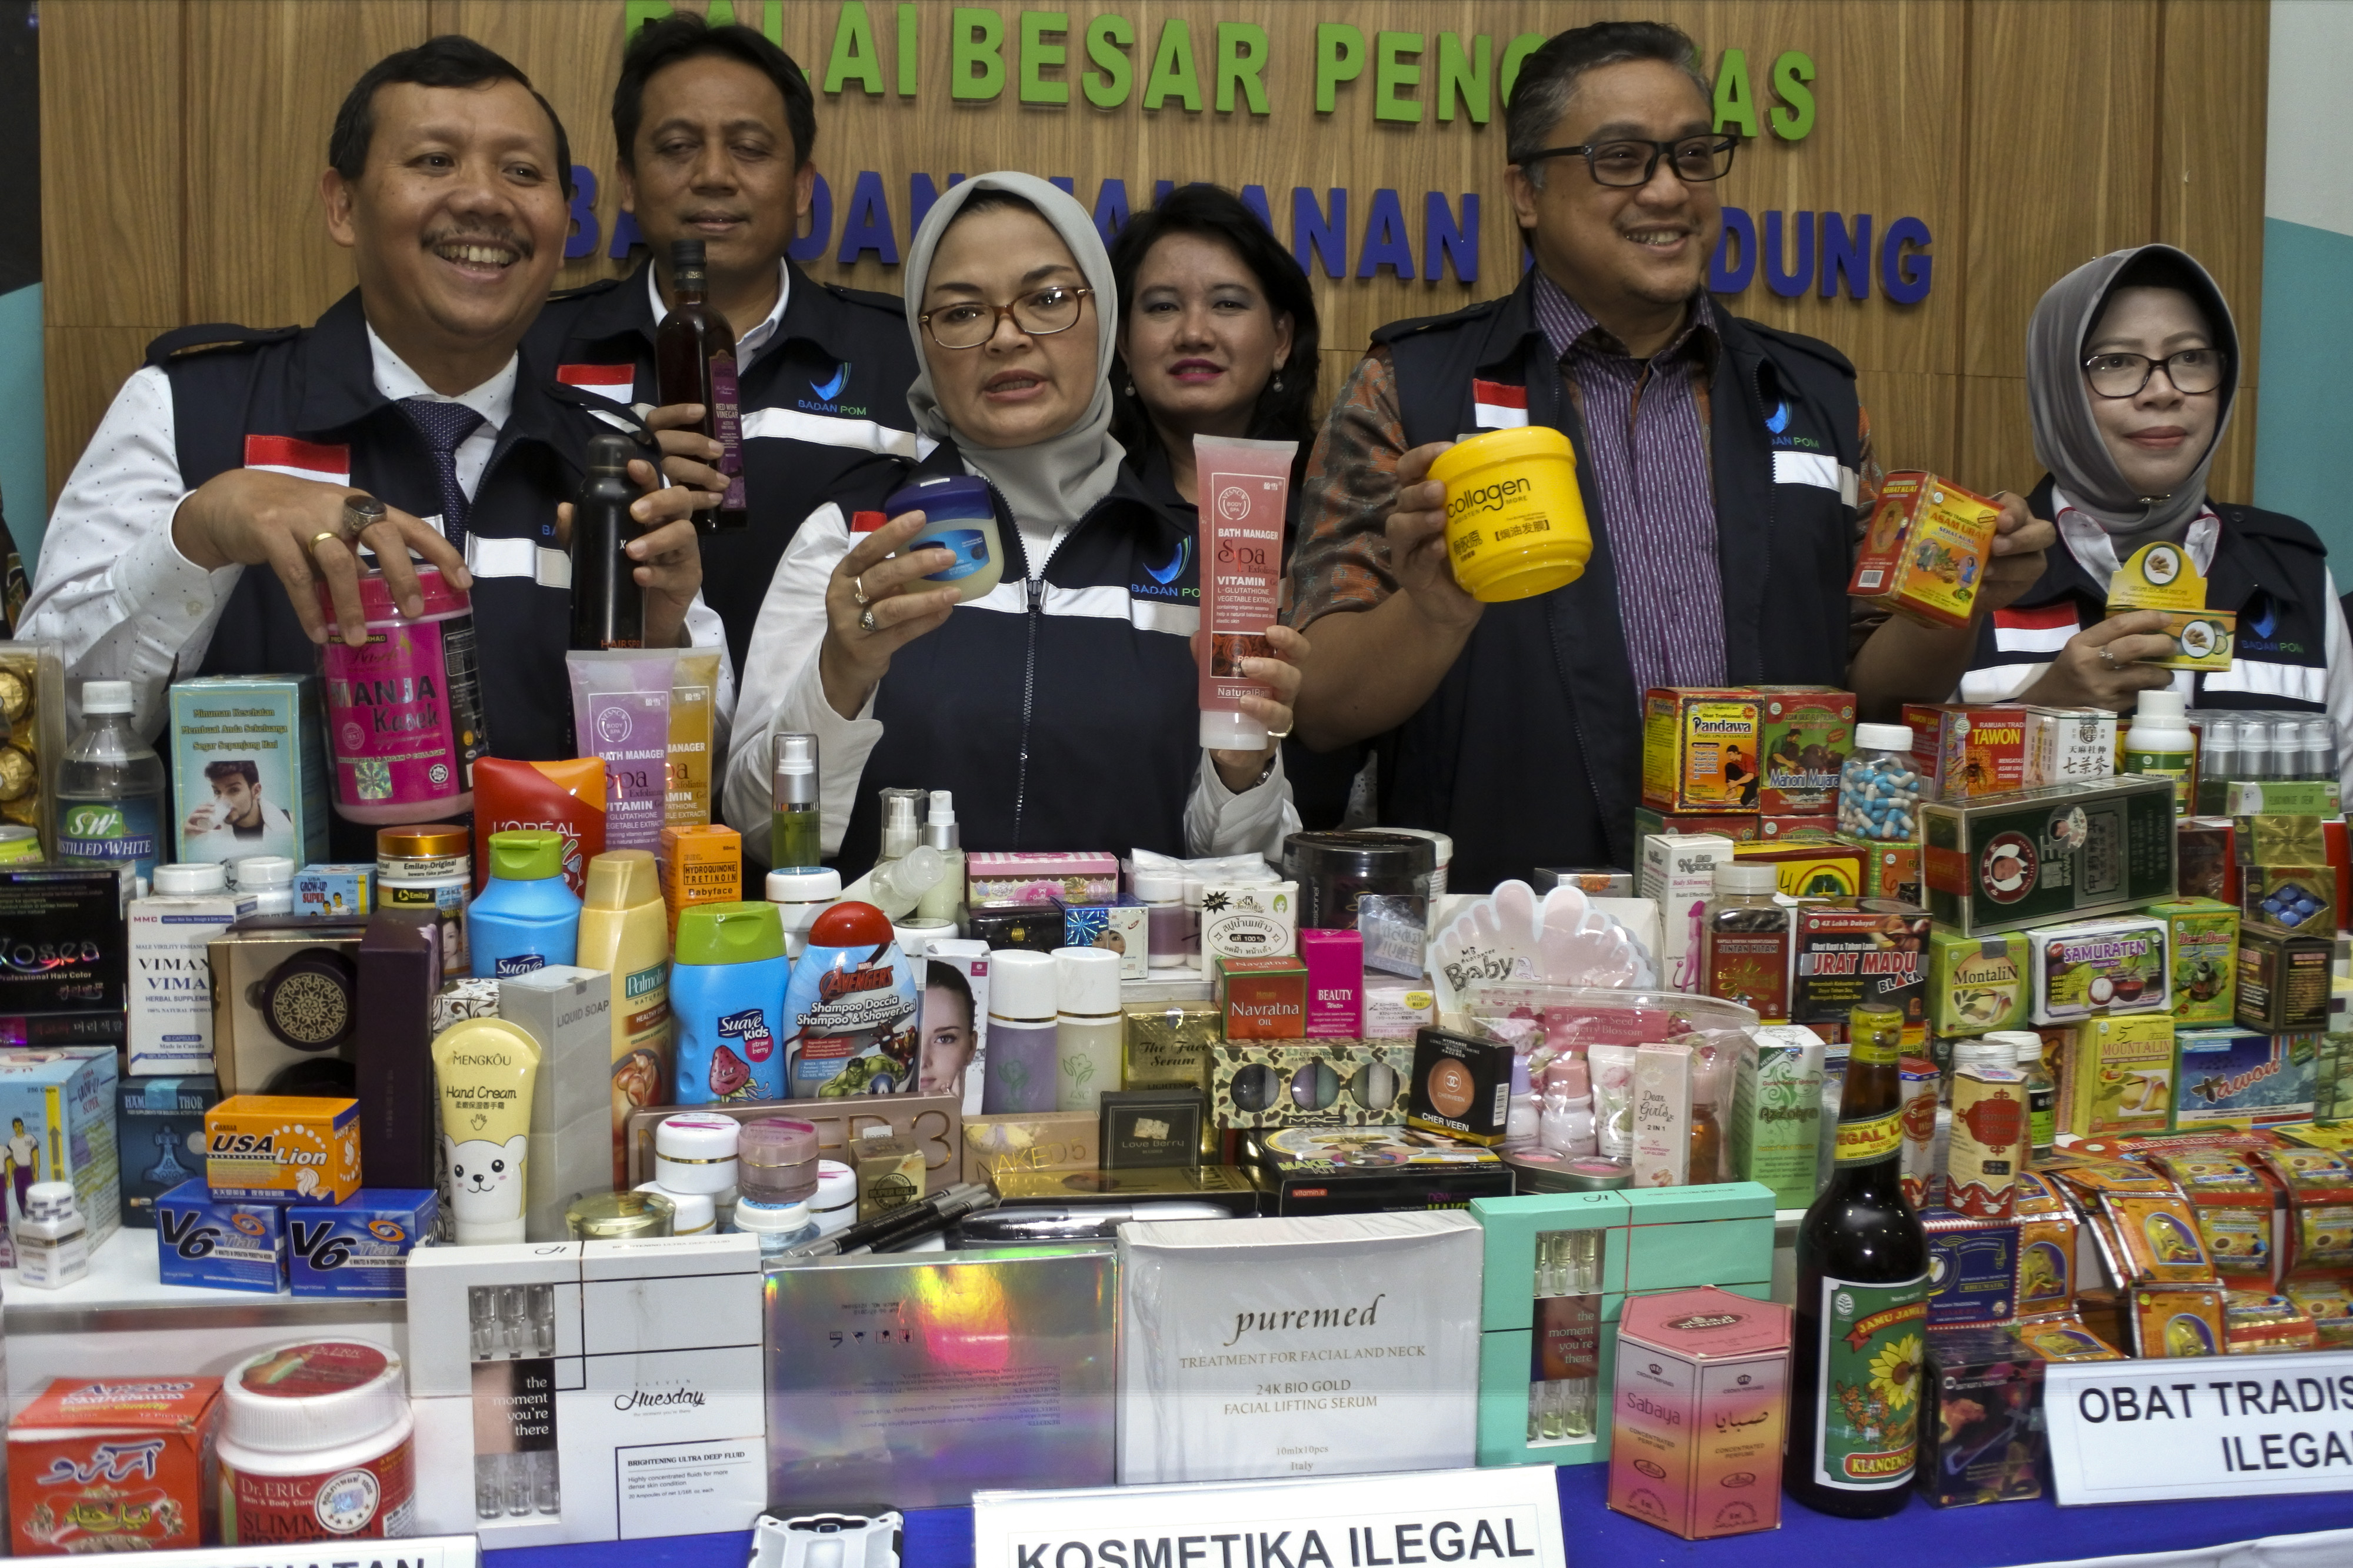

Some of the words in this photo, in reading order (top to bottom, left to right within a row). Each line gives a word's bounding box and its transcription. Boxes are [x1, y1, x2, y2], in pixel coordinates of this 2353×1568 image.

[952, 7, 1271, 116] BESAR
[1317, 22, 1815, 141] PENAS
[1709, 206, 1933, 305] DUNG
[716, 411, 739, 419] VINEGAR
[798, 399, 838, 413] BADAN
[841, 405, 866, 416] POM
[1794, 436, 1820, 449] POM
[1447, 478, 1531, 518] collagen
[1506, 495, 1528, 505] MORE
[1930, 512, 1960, 530] ASAM
[1218, 528, 1241, 538] BATH
[1242, 529, 1279, 541] MANAGER
[1218, 539, 1266, 573] Spa
[1217, 576, 1266, 587] VITAMIN
[1131, 583, 1178, 597] BADAN
[1181, 588, 1201, 598] PO
[1217, 587, 1270, 595] L-GLUTATHIONE
[2279, 642, 2304, 654] POM
[330, 676, 437, 708] MANJA
[193, 709, 232, 718] Minuman
[221, 725, 244, 733] Anda
[1692, 716, 1753, 734] Pandawa
[1972, 728, 2021, 745] TAWON
[193, 742, 216, 752] Segar
[261, 740, 278, 749] Hari
[599, 751, 624, 761] BATH
[625, 749, 665, 760] MANAGER
[1769, 769, 1807, 789] Mahoni
[106, 839, 152, 856] WHITE
[685, 863, 736, 874] HYDROQUINONE
[685, 873, 737, 884] TRETINOIN
[409, 891, 430, 900] Emilay
[688, 886, 733, 896] Babyface
[1718, 945, 1750, 953] JINTAN
[1751, 945, 1778, 953] HITAM
[2064, 939, 2147, 965] SAMURATEN
[138, 958, 209, 971] VIMAX
[1814, 952, 1859, 975] URAT
[1861, 951, 1918, 975] MADU
[1444, 953, 1514, 992] Baby
[147, 978, 208, 990] VIMA
[819, 965, 894, 1000] AVENGERS
[1318, 989, 1353, 1000] BEAUTY
[811, 1002, 863, 1013] Shampoo
[865, 995, 898, 1009] Doccia
[1231, 1002, 1299, 1017] Navratna
[556, 1007, 584, 1028] LIQUID
[585, 1000, 609, 1017] SOAP
[796, 1013, 849, 1027] Shampoo
[852, 1013, 860, 1023] &
[862, 1006, 901, 1021] Shower
[902, 999, 916, 1013] Gel
[1609, 1015, 1634, 1026] Seed
[1602, 1025, 1644, 1037] Blossom
[1138, 1040, 1167, 1054] The
[1170, 1040, 1208, 1054] Face
[2102, 1040, 2171, 1056] MOUNTALIN
[1149, 1055, 1197, 1067] Serum
[1759, 1049, 1784, 1068] HERBAL
[446, 1086, 476, 1099] Hand
[477, 1086, 517, 1099] Cream
[178, 1096, 204, 1109] THOR
[1422, 1112, 1444, 1126] CHER
[1446, 1119, 1469, 1132] VEEN
[211, 1133, 275, 1155] USA
[1121, 1140, 1150, 1149] Love
[1152, 1139, 1185, 1149] Berry
[1869, 1139, 1891, 1150] MANIS
[273, 1146, 328, 1166] Lion
[1295, 1189, 1325, 1197] vitamin.e
[1428, 1191, 1452, 1202] new
[159, 1209, 221, 1260] V6
[290, 1220, 358, 1272] V6
[1222, 1293, 1385, 1347] puremed
[1577, 1310, 1595, 1322] the
[1858, 1313, 1894, 1334] JAMU
[1548, 1325, 1594, 1337] moment
[1558, 1337, 1594, 1352] you're
[1179, 1352, 1267, 1370] TREATMENT
[1269, 1352, 1298, 1363] FOR
[1299, 1348, 1353, 1363] FACIAL
[1352, 1347, 1385, 1360] AND
[1387, 1345, 1427, 1358] NECK
[1564, 1352, 1593, 1364] there
[527, 1376, 547, 1389] the
[1256, 1382, 1283, 1396] 24K
[1284, 1380, 1309, 1393] BIO
[1311, 1379, 1351, 1392] GOLD
[493, 1392, 548, 1405] moment
[1224, 1402, 1272, 1416] FACIAL
[1275, 1398, 1328, 1412] LIFTING
[1330, 1396, 1378, 1409] SERUM
[2078, 1383, 2195, 1424] OBAT
[507, 1406, 549, 1422] you're
[1627, 1392, 1681, 1426] Sabaya
[515, 1423, 549, 1437] there
[1715, 1411, 1769, 1434] صبايا
[1629, 1427, 1675, 1448] CONCENTRATED
[1637, 1437, 1665, 1451] PERFUME
[1275, 1444, 1329, 1456] 10mlx10pcs
[1715, 1442, 1765, 1454] CONCENTRATED
[2222, 1430, 2353, 1472] ILEGA
[628, 1457, 677, 1467] BRIGHTENING
[678, 1454, 702, 1463] ULTRA
[704, 1453, 723, 1461] DEEP
[1290, 1460, 1314, 1472] Italy
[1851, 1453, 1907, 1473] KLANCENG
[648, 1473, 686, 1482] concentrated
[264, 1482, 311, 1499] ERIC
[635, 1491, 661, 1499] Ampoules
[1018, 1529, 1333, 1568] KOSMETIKA
[1349, 1517, 1535, 1567] ILEGAL
